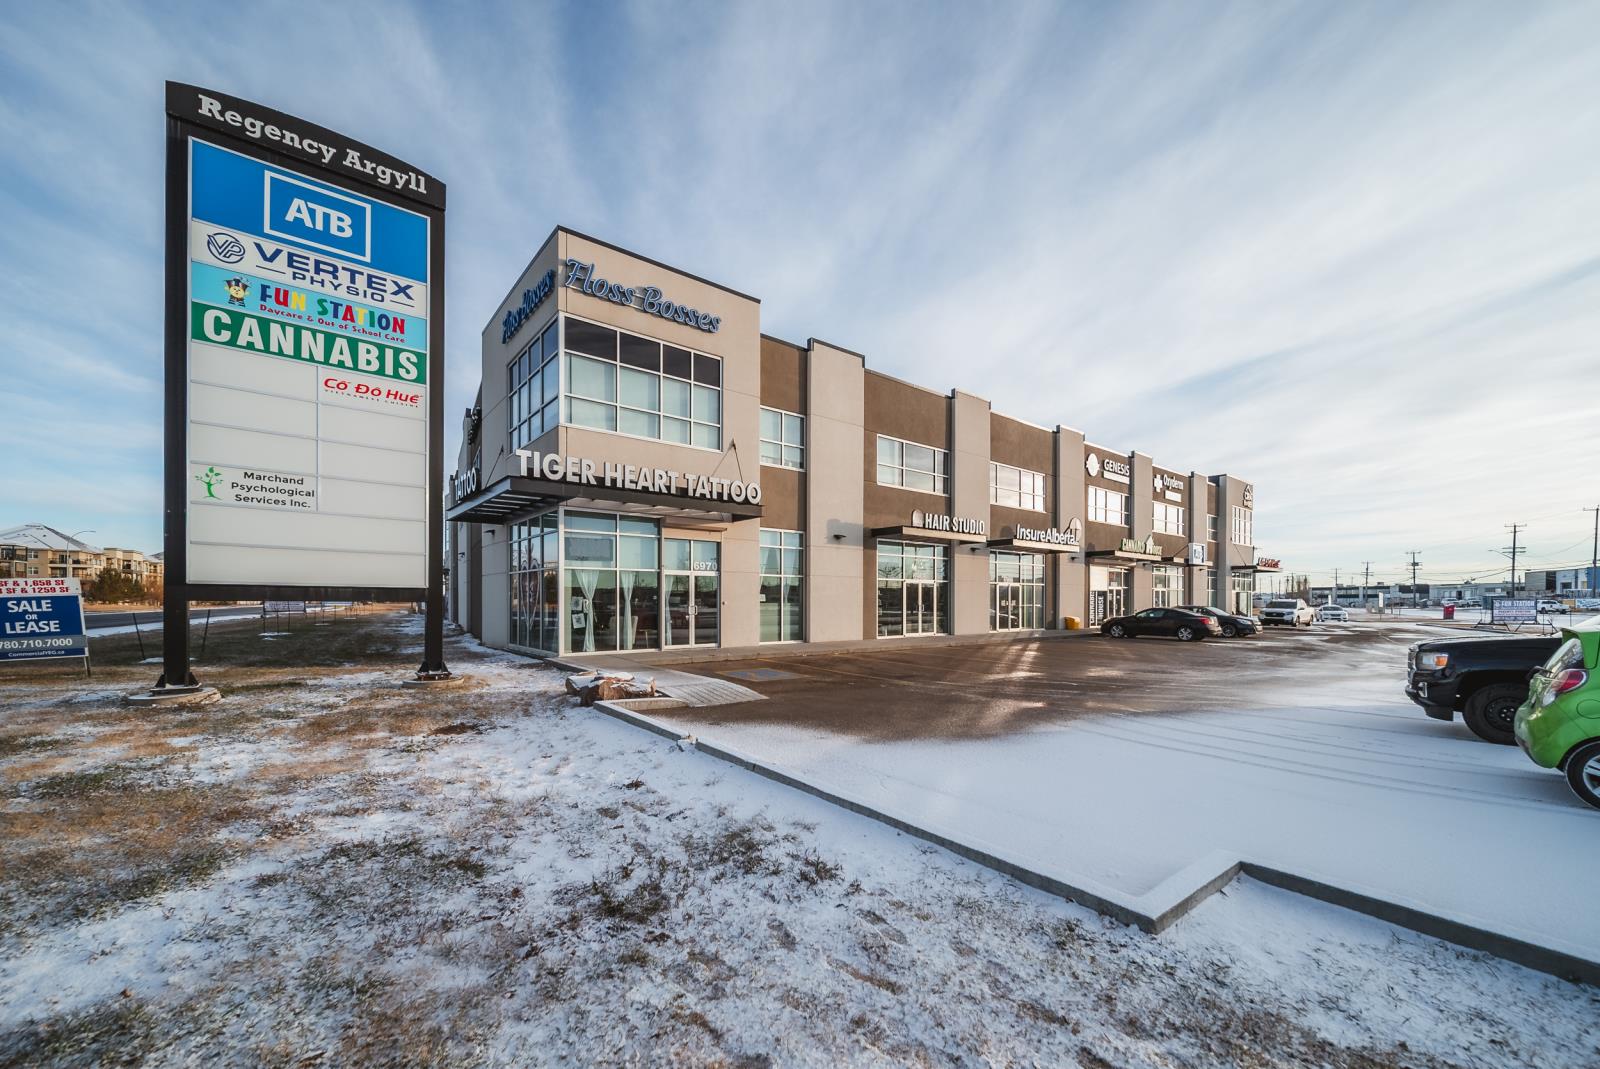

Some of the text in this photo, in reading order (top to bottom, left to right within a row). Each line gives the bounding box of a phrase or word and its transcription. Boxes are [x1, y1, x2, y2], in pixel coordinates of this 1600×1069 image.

[198, 94, 427, 194] Regency Argyll
[284, 198, 353, 238] ATB
[253, 241, 415, 301] VERTEX
[292, 271, 385, 303] PHYSIO
[260, 283, 406, 334] FUN STATION
[565, 258, 722, 334] Floss Bosses
[260, 304, 303, 320] Daycare
[317, 318, 335, 327] Out
[352, 326, 382, 338] School
[384, 333, 406, 343] Care
[203, 309, 419, 381] CANNABIS
[243, 471, 304, 485] Marchand
[516, 449, 762, 505] TIGER HEART TATTOO
[1103, 459, 1130, 476] GENESIS
[231, 482, 315, 497] Psychological
[234, 493, 311, 508] Services Inc.
[924, 513, 985, 534] HAIR STUDIO
[693, 561, 718, 570] 6970
[7, 599, 53, 613] SALE
[4, 620, 60, 634] LEASE
